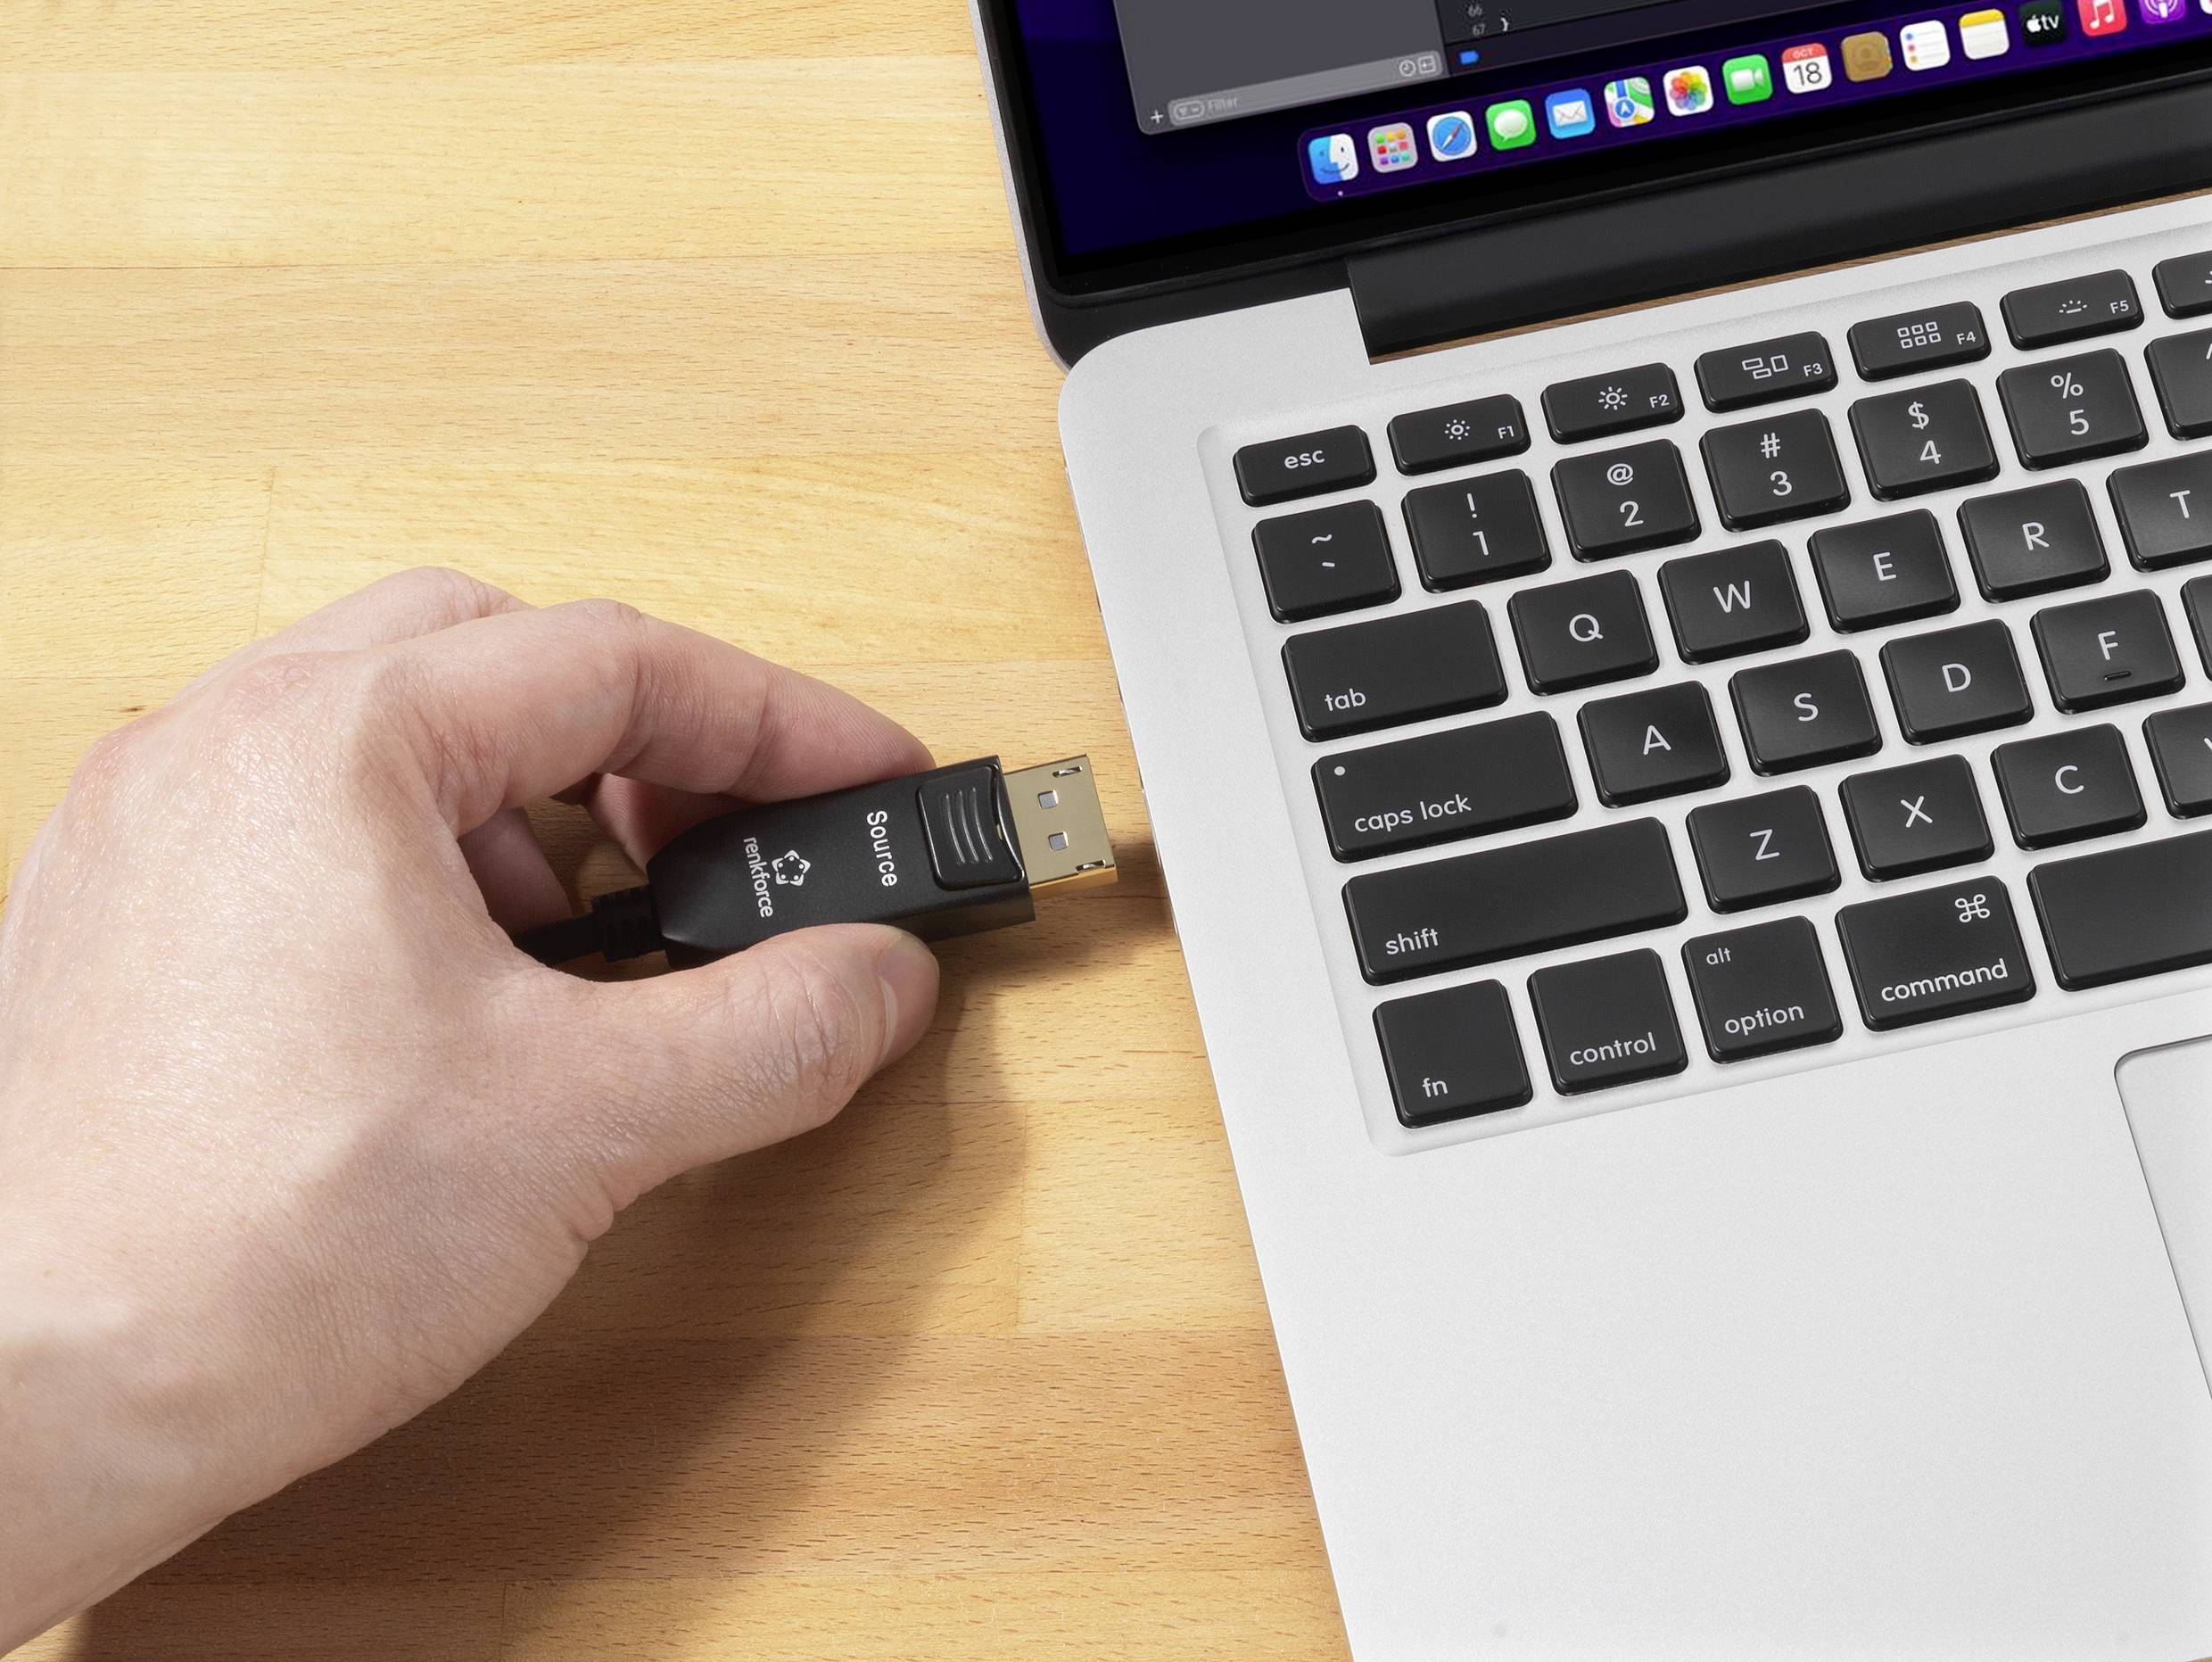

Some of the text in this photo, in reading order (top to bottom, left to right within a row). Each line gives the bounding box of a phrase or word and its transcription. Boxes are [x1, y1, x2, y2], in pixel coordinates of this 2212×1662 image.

[2040, 14, 2059, 30] tv
[1793, 48, 1814, 58] OCT
[1793, 62, 1822, 87] 18
[1208, 96, 1238, 112] Filter
[2110, 301, 2128, 313] F5
[1957, 332, 1976, 344] F4
[1803, 363, 1822, 376] F3
[2051, 373, 2084, 399] %
[1650, 394, 1669, 408] F2
[1909, 401, 1928, 429] $
[2070, 409, 2089, 434] 5
[1498, 426, 1514, 439] F1
[1761, 433, 1780, 459] #
[1920, 441, 1941, 464] 4
[1284, 451, 1325, 468] esc
[1607, 464, 1633, 485] @
[1770, 471, 1792, 495] 3
[1467, 493, 1477, 517] !
[1620, 501, 1643, 526] 2
[2170, 491, 2190, 518] T
[1473, 531, 1489, 555] 1
[2022, 523, 2049, 550] R
[1873, 552, 1896, 581] E
[1713, 581, 1750, 613] W
[1570, 614, 1603, 641] Q
[2098, 631, 2117, 660] F
[1942, 664, 1971, 692] D
[1325, 689, 1366, 711] tab
[1795, 693, 1818, 721] S
[1644, 725, 1671, 755] A
[2055, 765, 2084, 794] C
[1355, 794, 1471, 831] caps lock
[1901, 796, 1933, 827] X
[867, 811, 897, 886] Source
[1750, 830, 1779, 860] Z
[744, 837, 773, 918] renkforce
[1386, 928, 1438, 955] shift
[1706, 948, 1730, 964] alt
[1882, 958, 2008, 1001] command
[1725, 1006, 1803, 1035] option
[1571, 1032, 1655, 1064] control
[1423, 1078, 1448, 1097] fn
